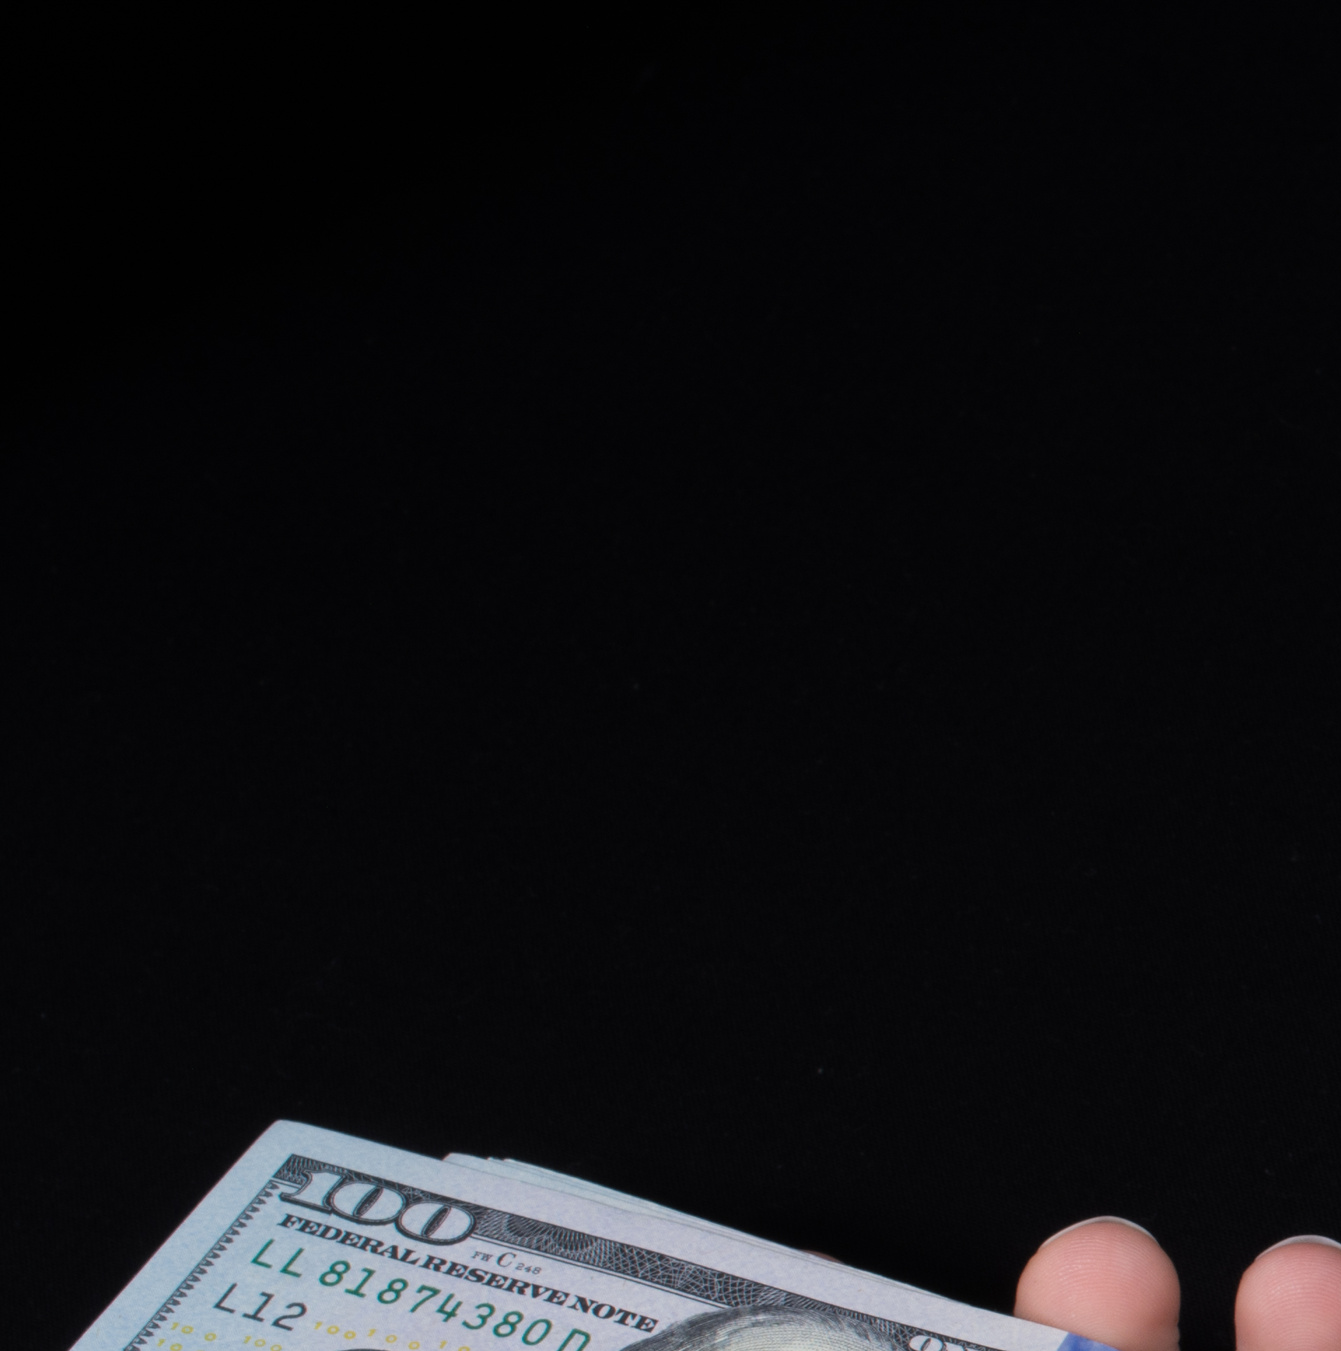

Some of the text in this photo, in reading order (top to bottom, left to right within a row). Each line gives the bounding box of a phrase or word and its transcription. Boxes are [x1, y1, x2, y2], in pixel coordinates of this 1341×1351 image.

[278, 1170, 477, 1246] 100
[251, 1239, 305, 1278] LL
[318, 1260, 553, 1346] 81874380
[277, 1213, 659, 1333] FEDERAL RESERVE NOTE
[471, 1250, 543, 1275] FW C 248
[213, 1282, 308, 1331] L12
